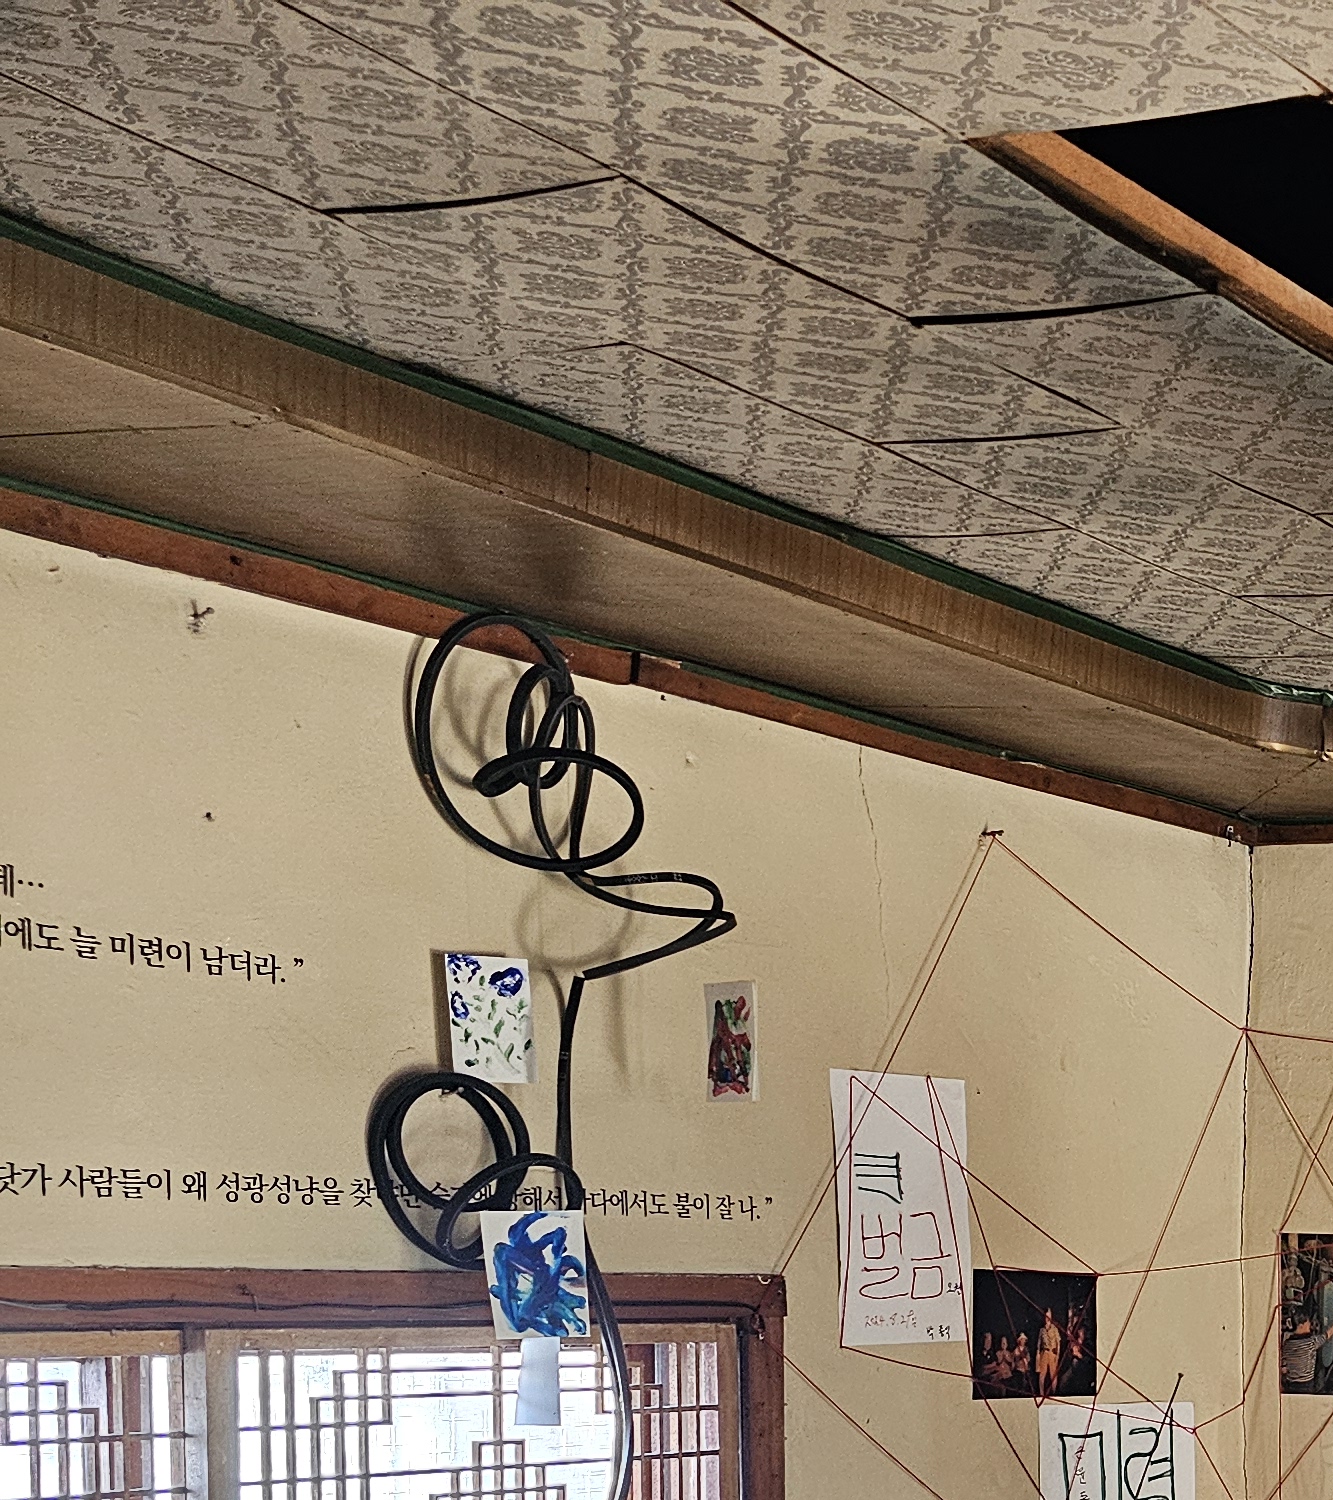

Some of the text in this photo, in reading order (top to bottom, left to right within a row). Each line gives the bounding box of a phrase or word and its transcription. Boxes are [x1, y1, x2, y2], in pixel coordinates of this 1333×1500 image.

[0, 913, 64, 951] 에도
[70, 925, 102, 960] 늘
[108, 932, 191, 972] 미련이
[58, 1164, 172, 1200] 사람들이
[181, 1170, 207, 1202] 왜
[216, 1171, 345, 1206] 성광성냥을
[673, 1192, 710, 1220] 불이
[716, 1194, 736, 1220] 잘
